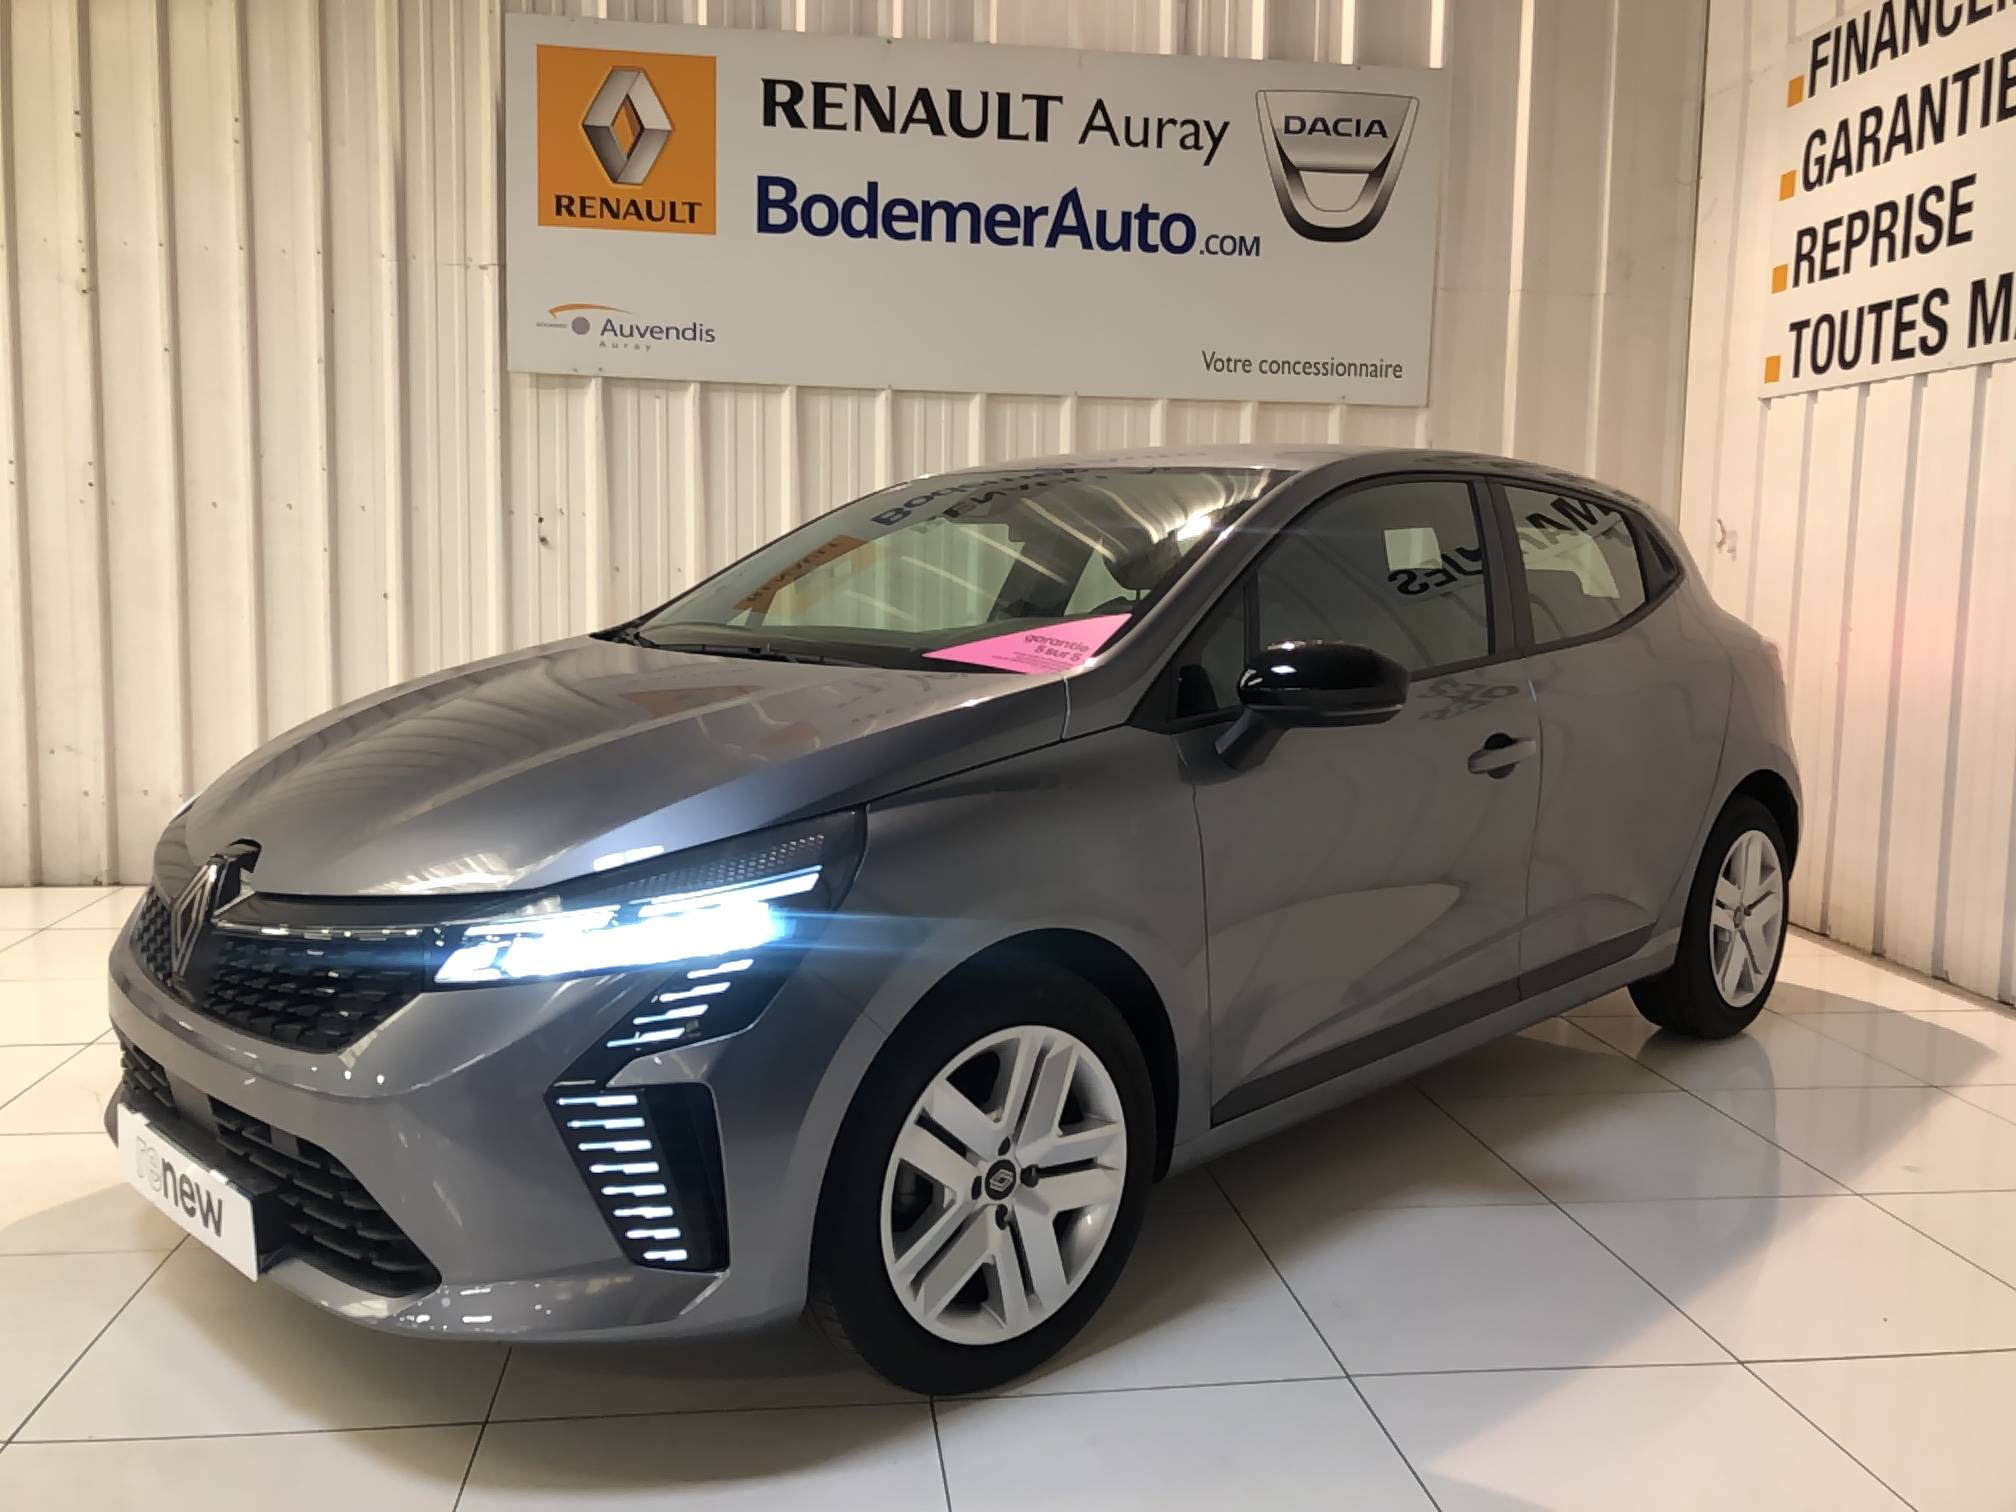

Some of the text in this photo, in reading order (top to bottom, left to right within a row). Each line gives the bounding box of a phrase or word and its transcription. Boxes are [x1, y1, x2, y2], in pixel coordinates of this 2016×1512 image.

[1808, 0, 2016, 98] FINANC
[761, 78, 1230, 166] RENAULT Auray
[1283, 115, 1388, 139] DACIA
[553, 194, 702, 225] RENAULT
[1792, 173, 1977, 288] REPRISE
[600, 317, 716, 343] Auvendis
[1789, 272, 2016, 378] TOUTES M
[1202, 350, 1403, 379] Votre concessionnaire
[1025, 635, 1089, 652] garantie
[1045, 648, 1070, 658] sur
[136, 1135, 223, 1238] renew
